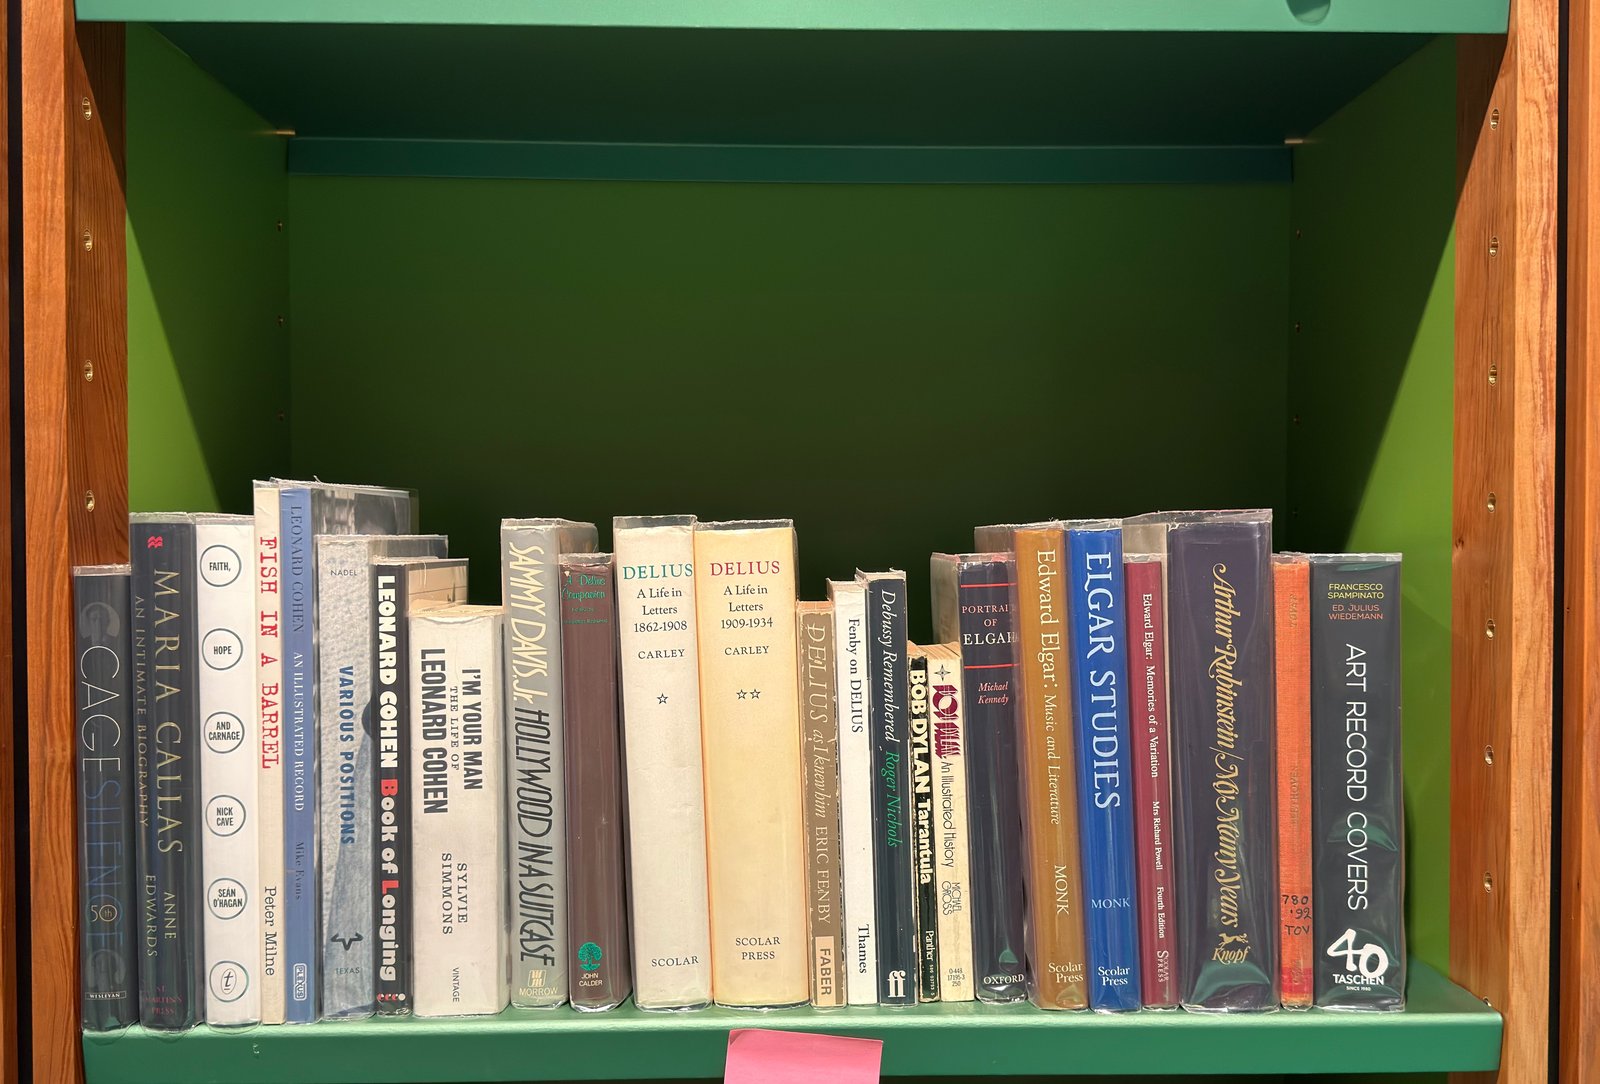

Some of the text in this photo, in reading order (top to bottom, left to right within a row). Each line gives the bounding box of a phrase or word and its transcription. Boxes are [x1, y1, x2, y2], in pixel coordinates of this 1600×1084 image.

[209, 562, 231, 572] FAITH,
[508, 542, 545, 616] SAMMY
[623, 563, 693, 580] DELIUS
[710, 561, 780, 577] DELIUS
[562, 587, 606, 602] Companion
[637, 587, 682, 599] A Life in
[723, 584, 768, 596] A Life in
[642, 605, 678, 616] Letters
[728, 602, 764, 612] Letters
[1142, 594, 1153, 628] Edward
[1347, 604, 1379, 612] JULIUS
[634, 620, 687, 633] 1862-1908
[721, 617, 773, 629] 1909-1934
[983, 619, 997, 627] OF
[213, 645, 232, 655] HOPE
[260, 536, 279, 769] FISH IN A BARREL
[290, 505, 305, 811] LEONARD COHEN AN ILLUSTRATED RECORD
[638, 649, 685, 660] CARLEY
[724, 645, 769, 656] CARLEY
[1142, 631, 1154, 660] Elgar:
[806, 623, 828, 723] DELIUS
[846, 618, 863, 733] Fenby on DELIUS
[978, 681, 1008, 691] Michael
[1084, 551, 1120, 809] ELGAR STUDIES
[512, 681, 548, 704] Jr.
[978, 694, 1009, 705] Kennedy
[1037, 549, 1061, 825] Edward Elgar: Music and Literature
[1146, 665, 1156, 712] Memories
[81, 645, 121, 772] CAGE
[135, 596, 149, 827] AN INTIMATE BIOGRAPHY
[153, 569, 183, 853] MARIA CALLAS
[932, 685, 959, 720] BOB
[216, 722, 231, 730] AND
[420, 648, 448, 814] LEONARD COHEN
[450, 687, 459, 770] THE LIFE OF
[462, 668, 483, 790] I'M YOUR MAN
[878, 590, 903, 847] Debussy Remembered Roger Nichols
[1148, 714, 1156, 725] of
[208, 731, 240, 740] CARNAGE
[813, 729, 824, 745] as
[1212, 563, 1242, 928] Arthur Many Years
[339, 665, 355, 844] VARIOUS POSITIONS
[941, 761, 954, 774] An
[1149, 736, 1159, 778] Variation
[378, 575, 399, 981] LEONARD COHEN Book of Longing
[515, 707, 553, 838] HOLLYWOOD
[910, 669, 934, 884] BOB DYLAN Tarantula
[1345, 643, 1368, 910] ART RECORD COVERS
[216, 807, 233, 816] NICK
[941, 776, 956, 829] Illustrated
[216, 817, 234, 826] CAVE
[1153, 817, 1162, 845] Richard
[83, 780, 124, 946] SILENCE
[518, 841, 553, 863] IN
[942, 834, 957, 867] History
[1154, 847, 1163, 870] Powell
[296, 841, 305, 900] Mike Evans
[815, 826, 831, 924] ERIC FENBY
[213, 898, 243, 908] O'HAGAN
[218, 887, 236, 897] SEÁN
[441, 853, 452, 935] SIMMONS
[457, 863, 467, 923] SYLVIE
[942, 881, 952, 915] GROSS
[951, 882, 961, 912] MICHAEL
[1054, 865, 1069, 916] MONK
[1091, 898, 1130, 909] MONK
[1156, 886, 1164, 911] Fourth
[1282, 895, 1309, 905] 780
[145, 875, 158, 957] EDWARDS
[164, 891, 176, 939] ANNE
[519, 880, 555, 967] SUITCASE
[1157, 913, 1165, 939] Edition
[264, 886, 278, 976] Peter Milne
[735, 936, 781, 946] SCOLAR
[1285, 925, 1310, 935] TOV
[741, 950, 775, 960] PRESS
[858, 924, 869, 974] Thames
[925, 930, 935, 961] Panther
[1211, 946, 1251, 965] Knopf
[1327, 928, 1389, 978] 40
[651, 955, 699, 967] SCOLAR
[820, 948, 832, 995] FABER
[1048, 962, 1083, 972] Scolar
[1098, 966, 1130, 976] Scolar
[519, 987, 558, 996] MORROW
[887, 970, 906, 998] ff
[983, 975, 1024, 985] OXFORD
[1056, 973, 1083, 983] Press
[1102, 976, 1128, 986] Press
[1332, 974, 1384, 986] TASCHEN
